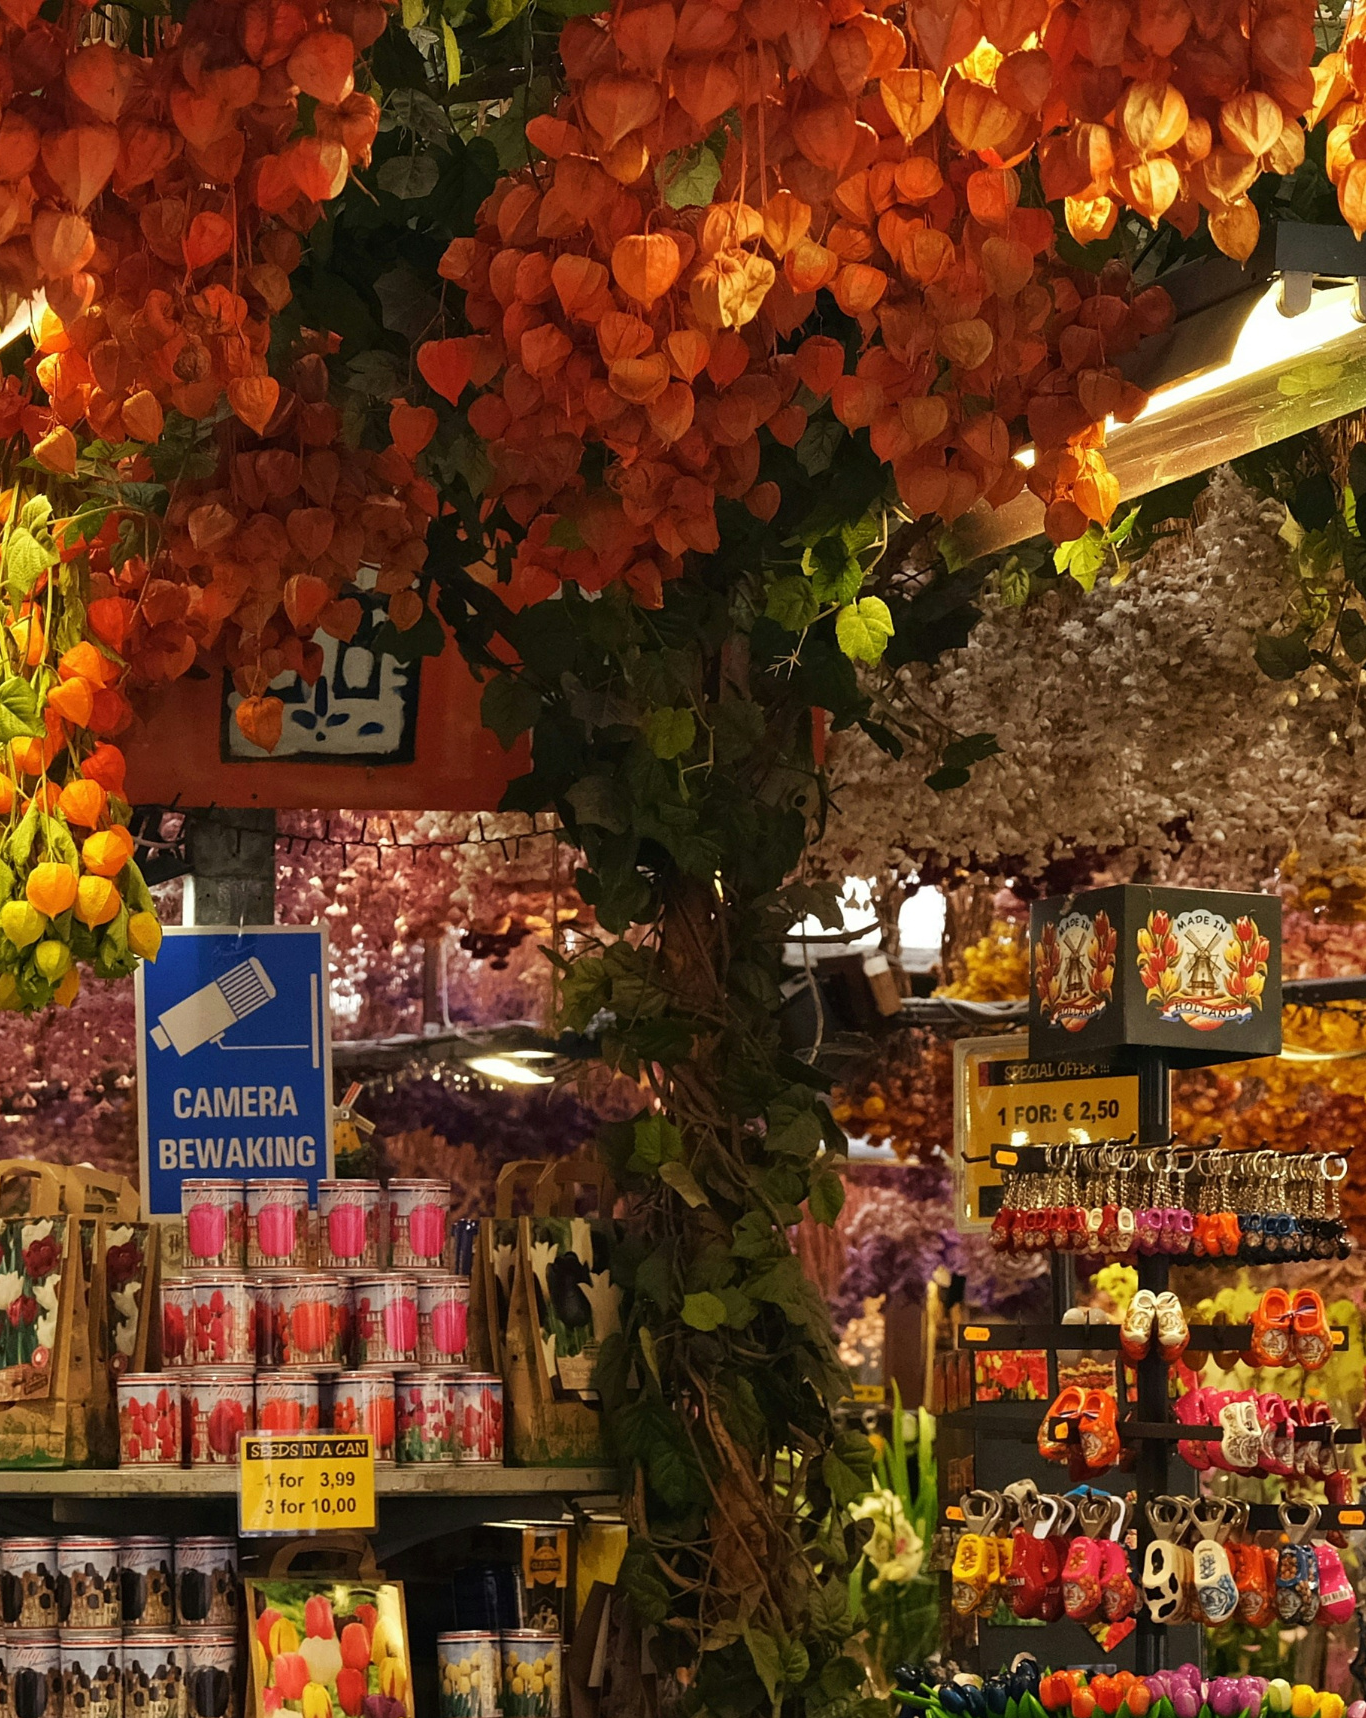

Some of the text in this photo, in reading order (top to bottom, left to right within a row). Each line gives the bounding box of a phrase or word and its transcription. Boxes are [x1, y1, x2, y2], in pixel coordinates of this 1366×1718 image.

[1059, 918, 1092, 936] MADE IN
[1176, 914, 1229, 934] MADE IN
[1174, 1001, 1238, 1018] HOLLAND
[1004, 1063, 1055, 1081] SPECIAL
[1057, 1061, 1097, 1077] OFFER
[173, 1086, 298, 1118] CAMERA
[997, 1099, 1120, 1126] 1 FOR: € 2,50
[159, 1135, 316, 1170] BEWAKING
[250, 1442, 366, 1458] SEEDS IN A CAN
[264, 1471, 355, 1489] 1 for 3,99
[265, 1497, 356, 1516] 3 for 10,00
